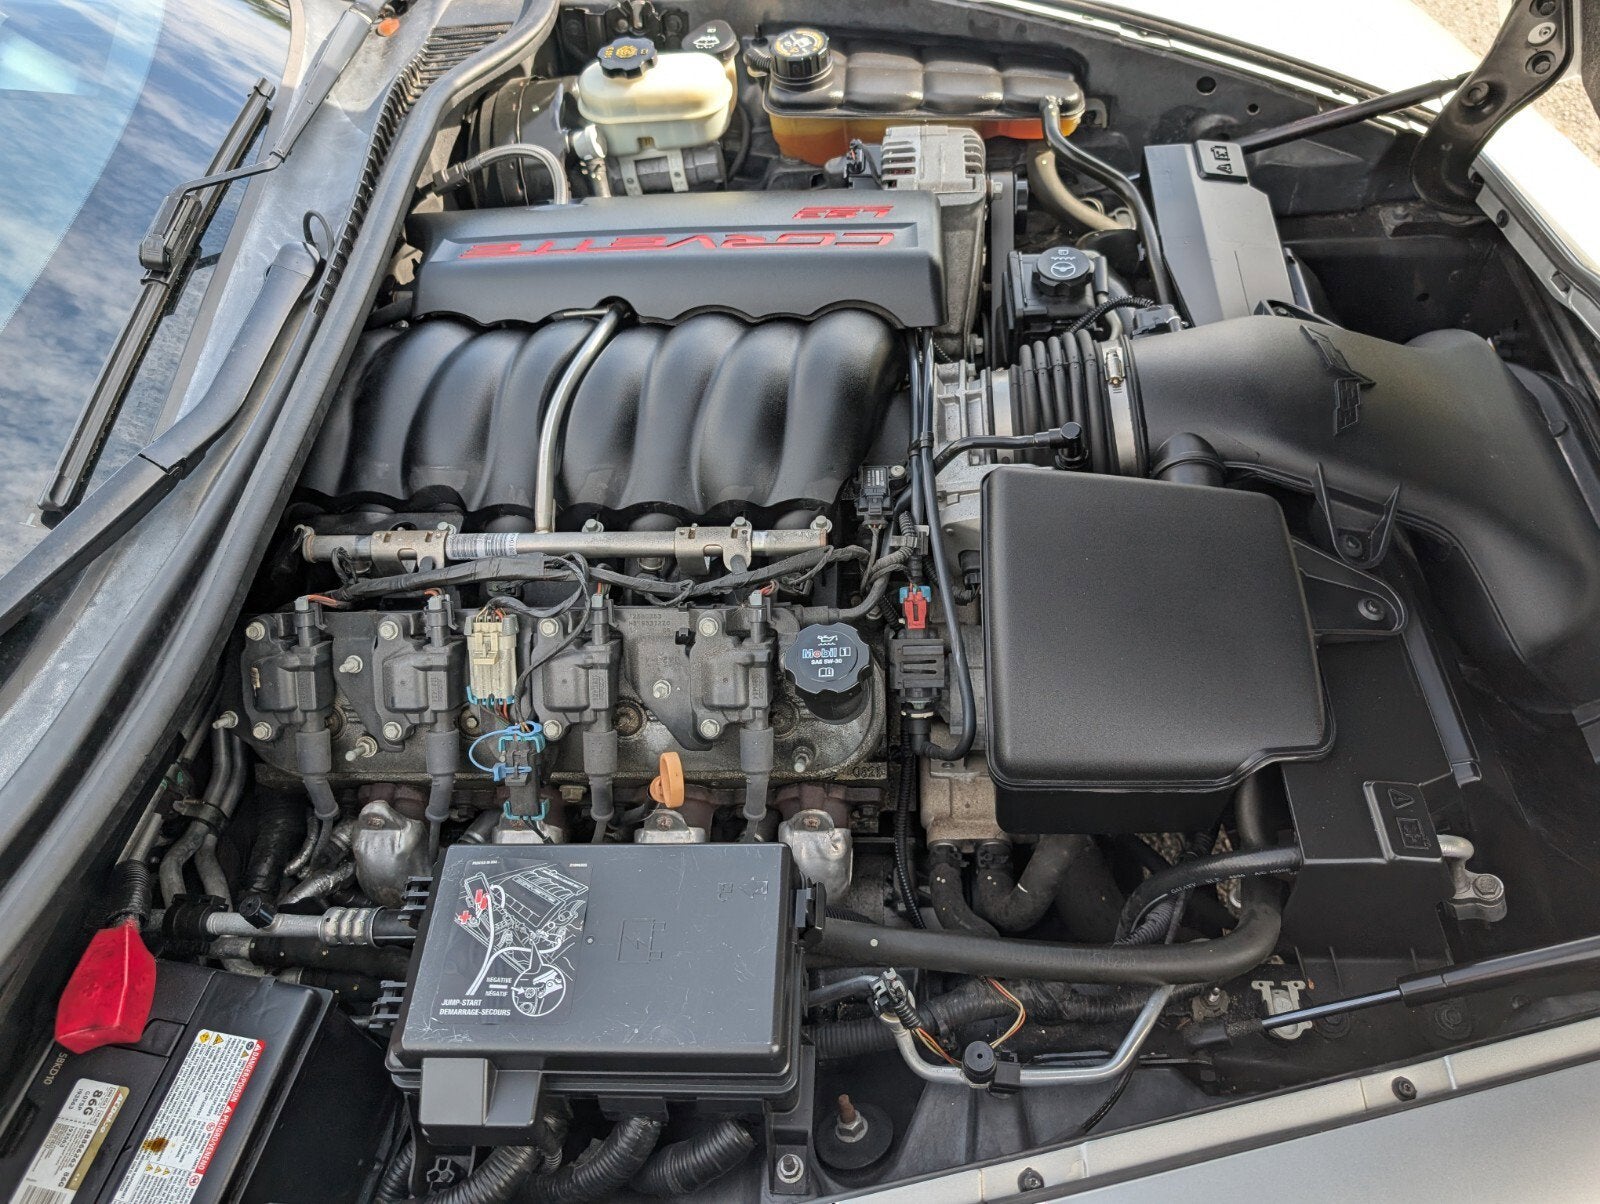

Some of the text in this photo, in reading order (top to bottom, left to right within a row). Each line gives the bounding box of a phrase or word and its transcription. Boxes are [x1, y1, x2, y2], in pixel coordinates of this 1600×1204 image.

[793, 205, 894, 221] LS3
[457, 231, 894, 260] CORVETTE
[802, 647, 837, 659] Mobil
[229, 1050, 260, 1102] DANGER/POISON
[83, 1089, 103, 1115] 86G
[197, 1113, 229, 1170] PELIGRO/VENENO
[58, 1171, 70, 1187] 86G
